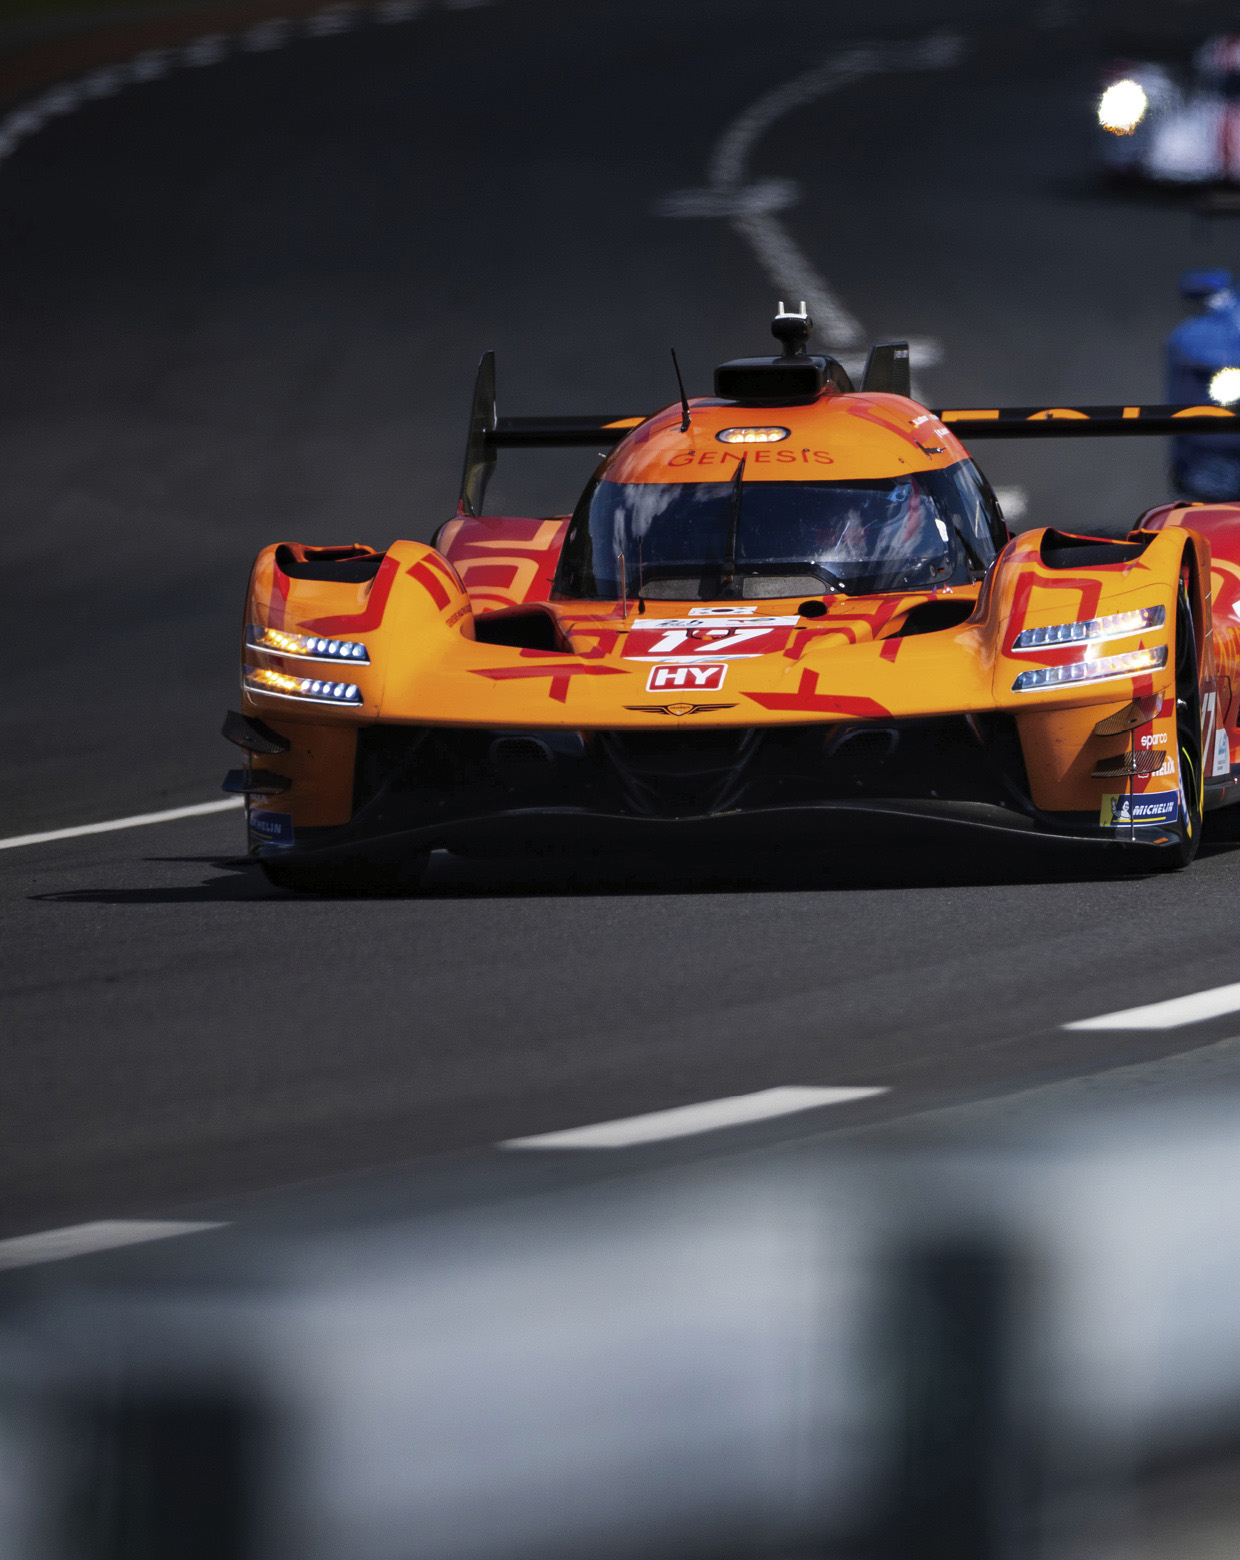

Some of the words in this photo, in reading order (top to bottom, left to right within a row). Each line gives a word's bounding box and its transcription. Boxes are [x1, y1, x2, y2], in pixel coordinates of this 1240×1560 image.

[667, 450, 835, 467] GENESIS
[648, 627, 774, 653] 17
[654, 667, 720, 687] HY
[1140, 732, 1168, 750] sparco
[1132, 801, 1174, 816] MICHELIN
